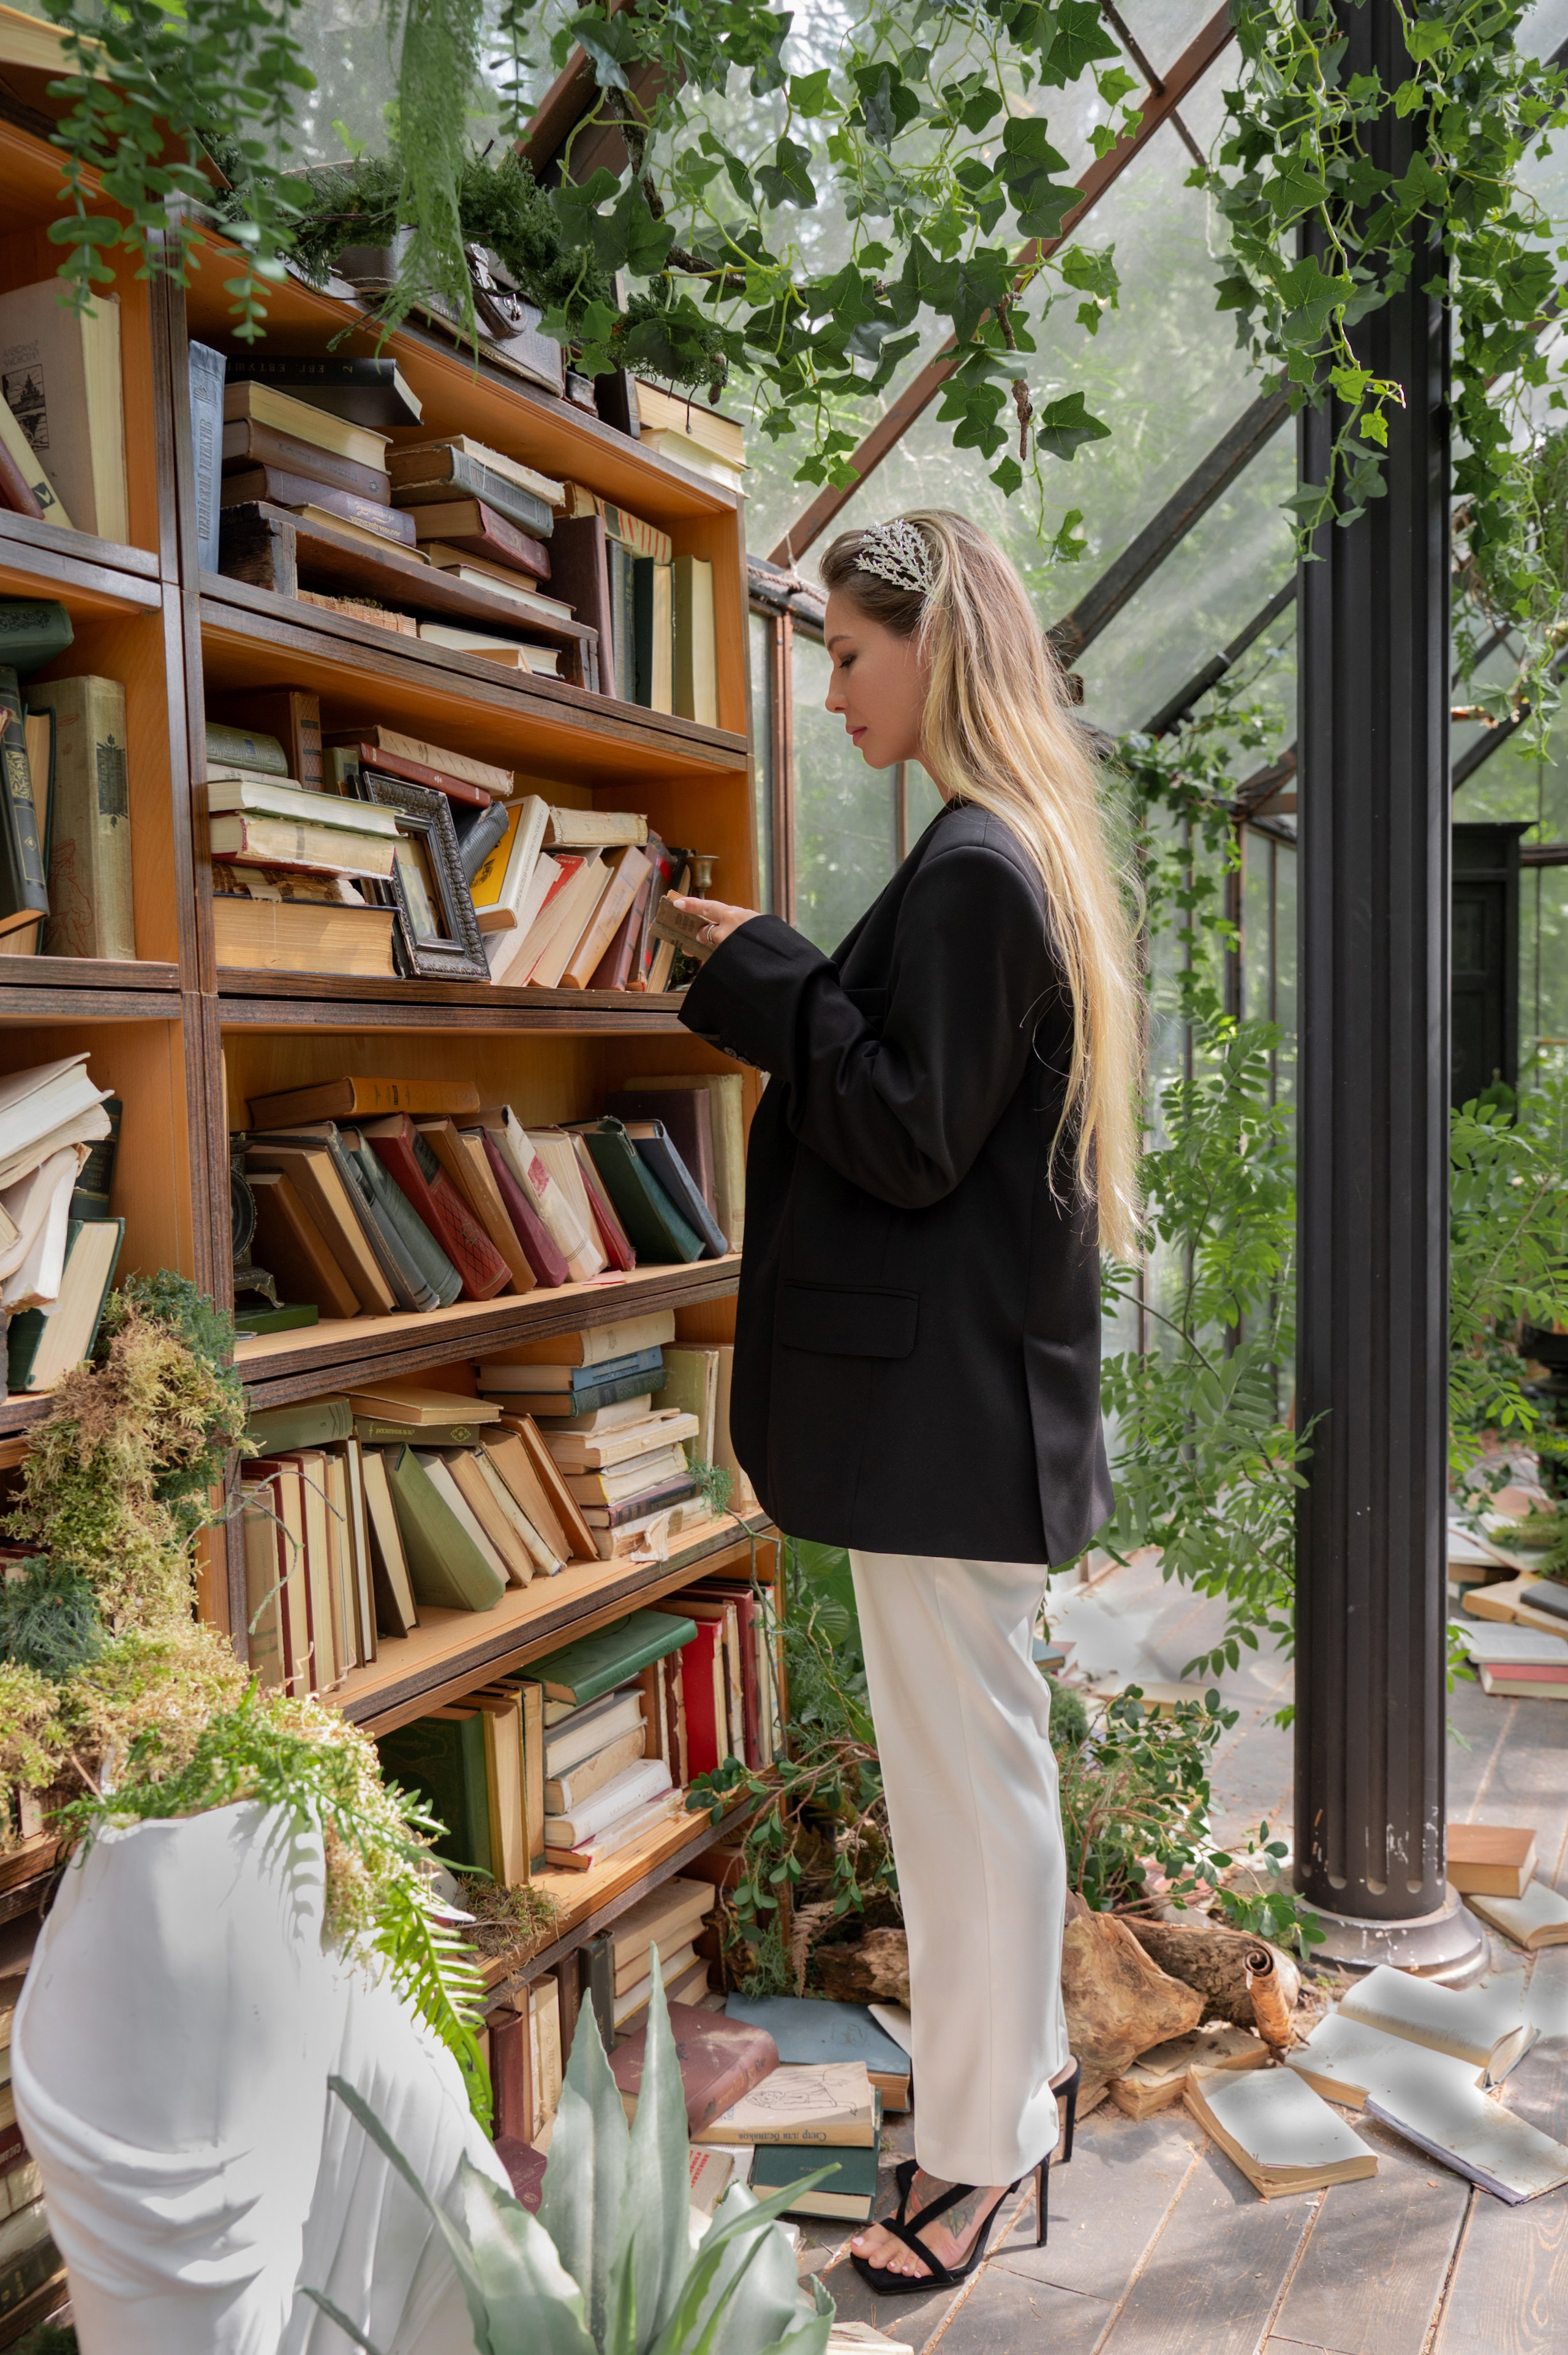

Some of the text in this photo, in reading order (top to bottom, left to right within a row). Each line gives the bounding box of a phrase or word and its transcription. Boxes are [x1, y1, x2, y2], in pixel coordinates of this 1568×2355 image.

[198, 418, 213, 476] ДЕТЕКТИВ
[350, 515, 401, 537] МАРИНА ЦВЕТАЕВА
[738, 2131, 780, 2142] бедняков
[802, 2130, 827, 2142] Сидр
